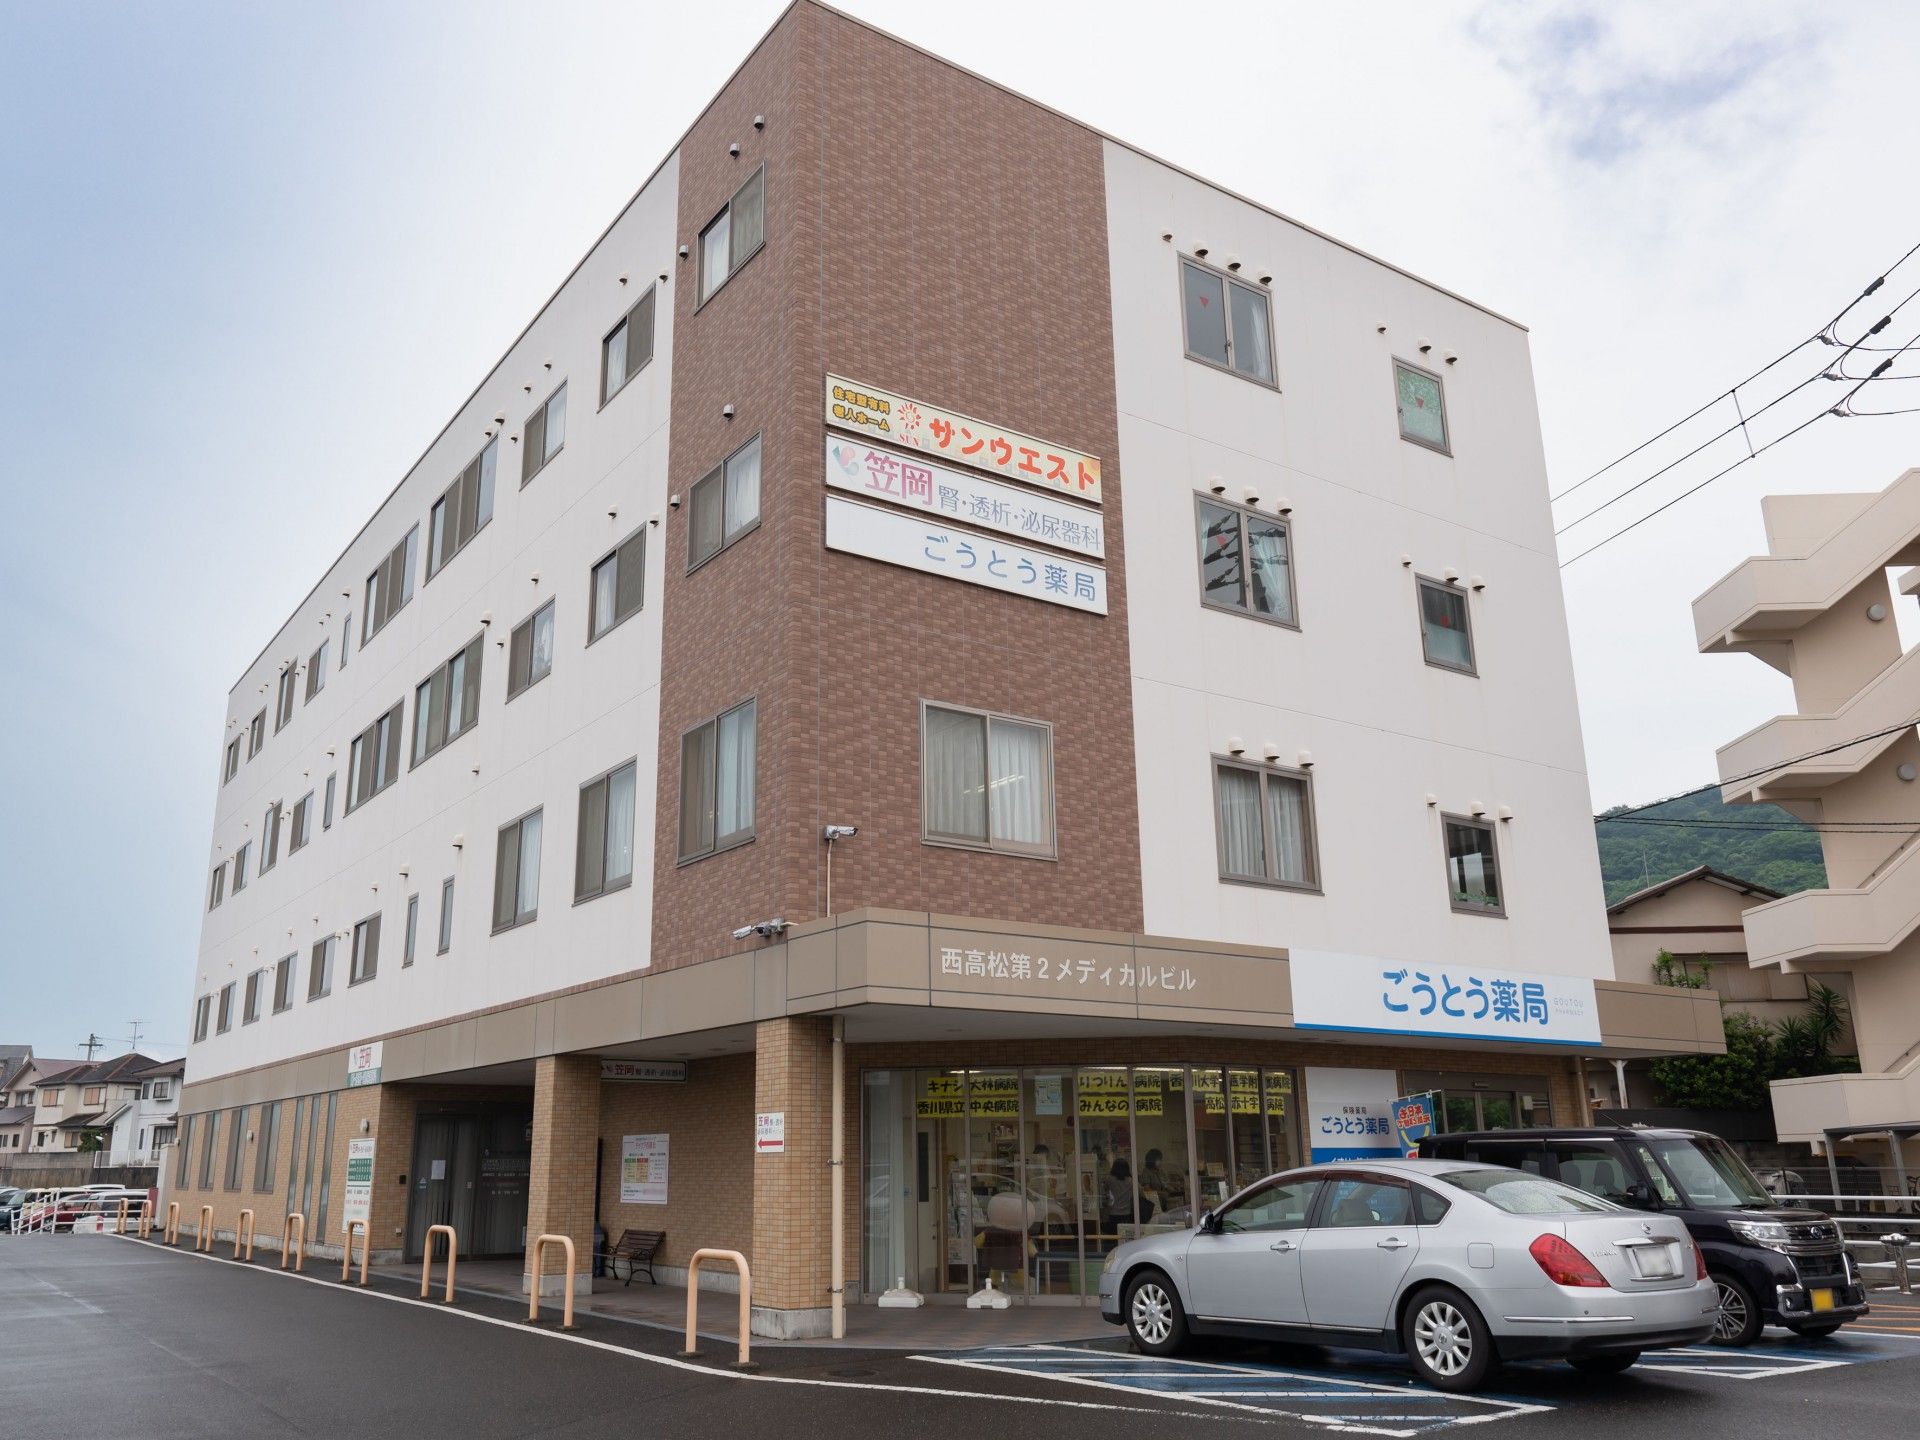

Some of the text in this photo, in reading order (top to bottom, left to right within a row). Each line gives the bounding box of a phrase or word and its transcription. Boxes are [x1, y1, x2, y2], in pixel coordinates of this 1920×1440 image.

[832, 385, 891, 415] 住宅型有料
[832, 404, 891, 432] 老人ホーム
[898, 433, 921, 447] SUN
[929, 418, 1095, 492] サンウエスト
[864, 450, 933, 505] 笠岡
[924, 535, 1096, 602] ごうとう薬局
[940, 947, 1197, 993] 西高松第2メディカルビル
[1382, 967, 1549, 1026] ごうとう薬局
[1321, 1116, 1390, 1136] ごうとう薬局
